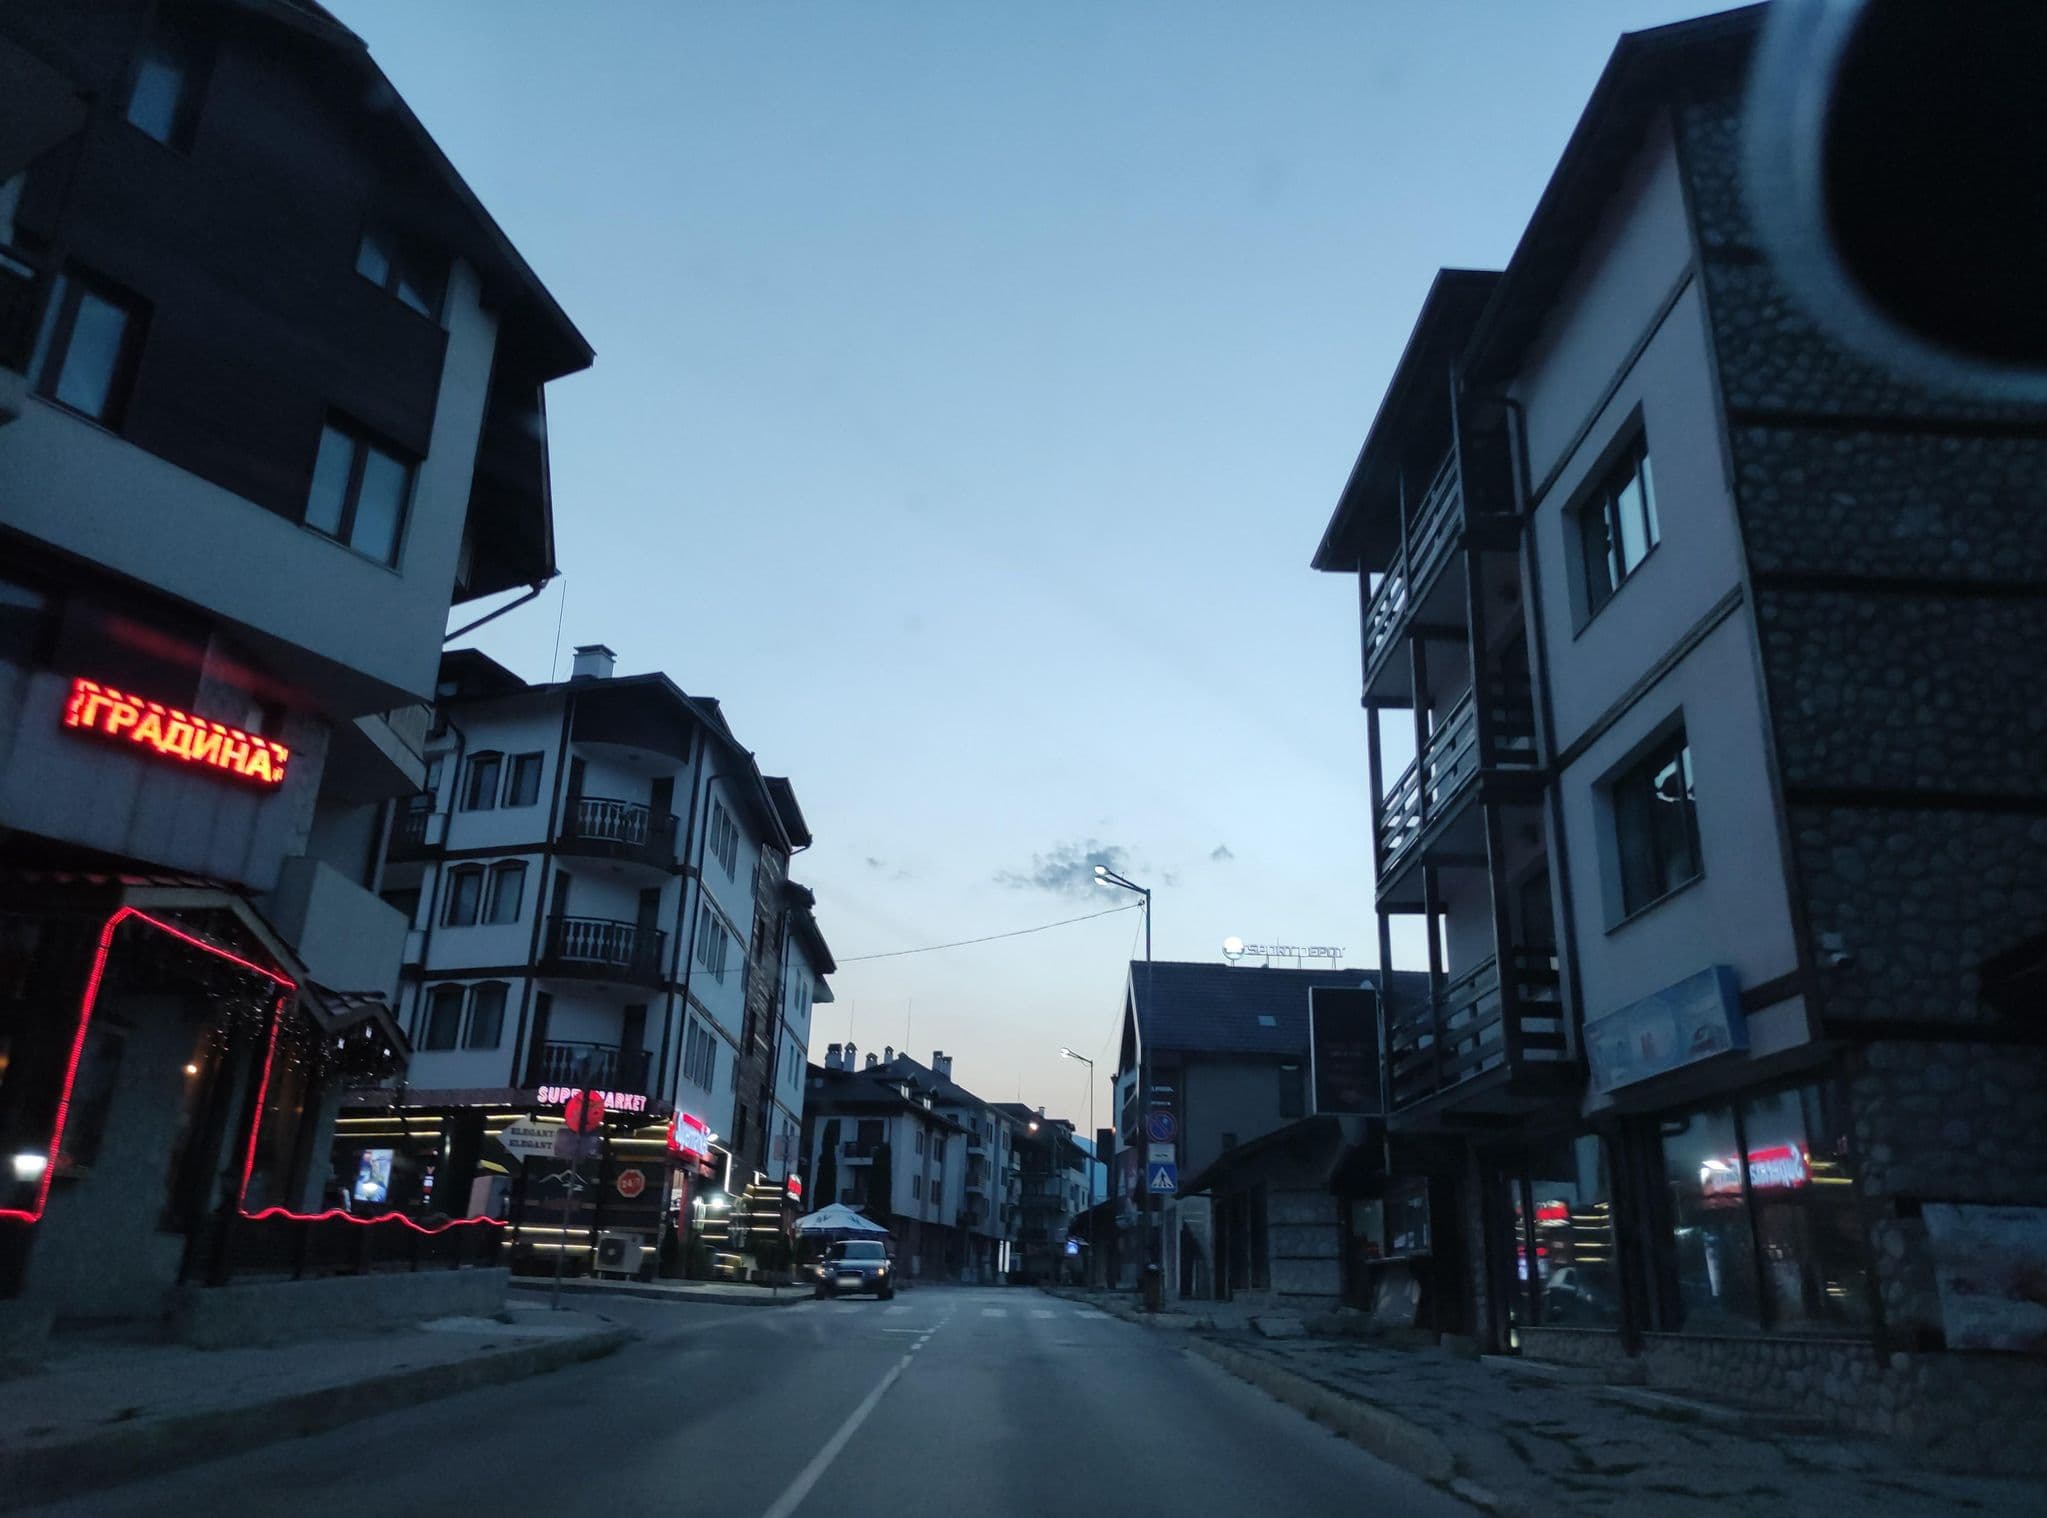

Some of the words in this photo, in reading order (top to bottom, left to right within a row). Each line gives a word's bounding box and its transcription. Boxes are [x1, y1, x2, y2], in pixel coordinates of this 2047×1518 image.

[81, 692, 273, 783] ГРАДИНА
[537, 1085, 647, 1112] SUPARKET
[511, 1127, 554, 1137] ELEGANT
[509, 1139, 552, 1149] ELEGANT
